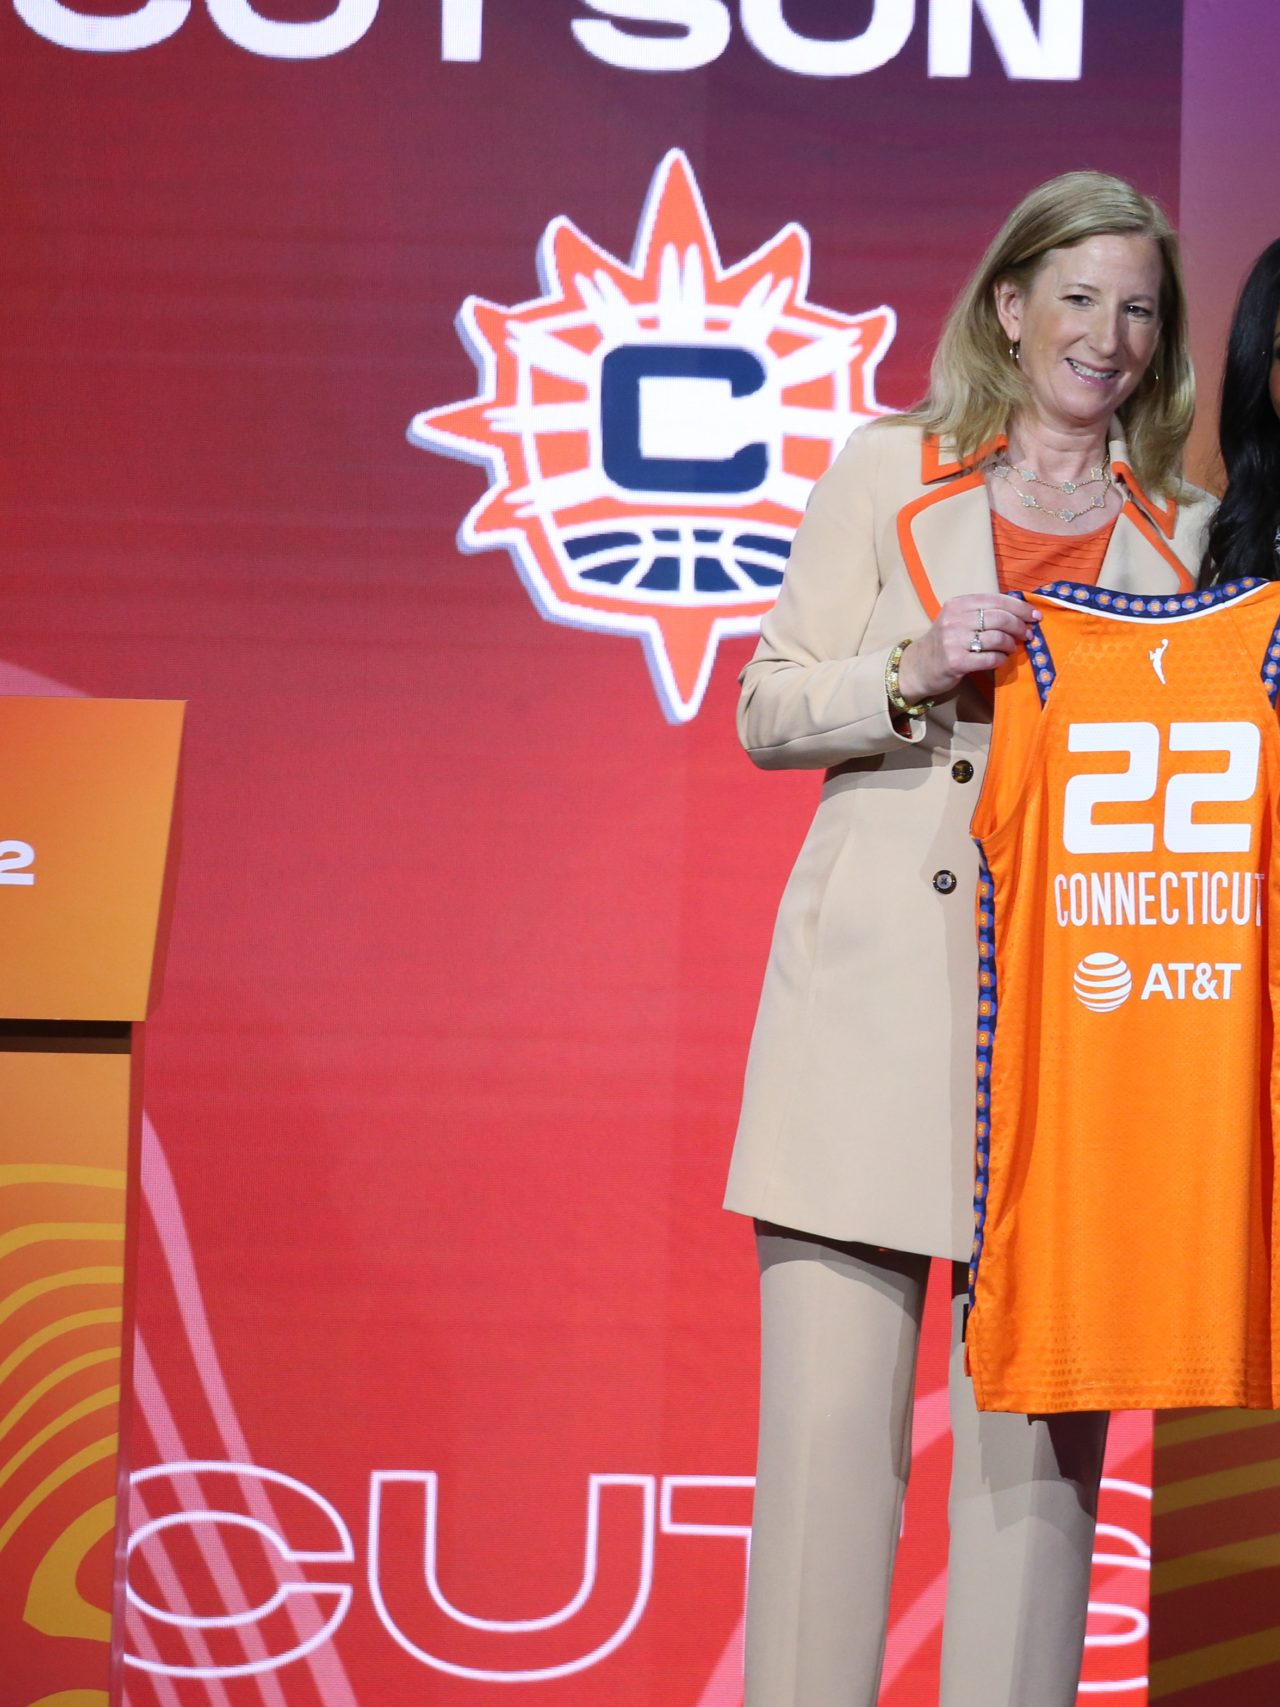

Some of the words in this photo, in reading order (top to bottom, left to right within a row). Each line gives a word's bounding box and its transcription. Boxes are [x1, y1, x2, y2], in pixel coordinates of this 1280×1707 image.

[1062, 721, 1261, 854] 22
[1054, 870, 1265, 928] CONNECTICUT
[1140, 963, 1242, 1000] AT&T
